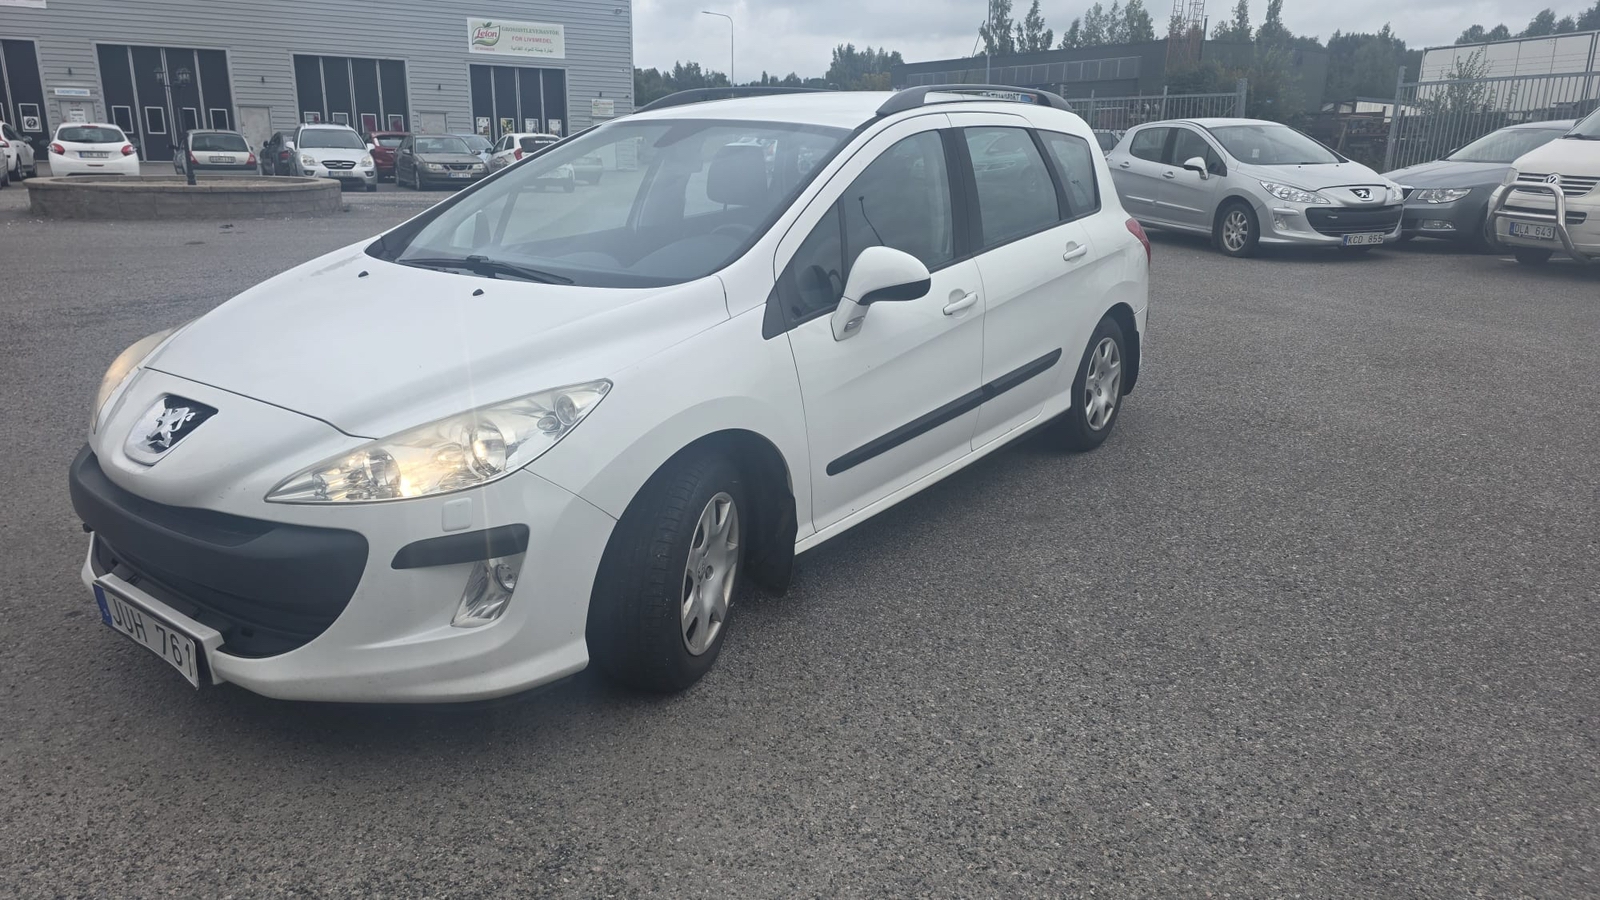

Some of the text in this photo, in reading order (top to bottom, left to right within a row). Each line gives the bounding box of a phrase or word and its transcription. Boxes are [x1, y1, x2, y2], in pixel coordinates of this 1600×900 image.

[1535, 226, 1552, 237] 643
[1348, 234, 1383, 244] KCD 855
[113, 599, 192, 677] JUH 761
